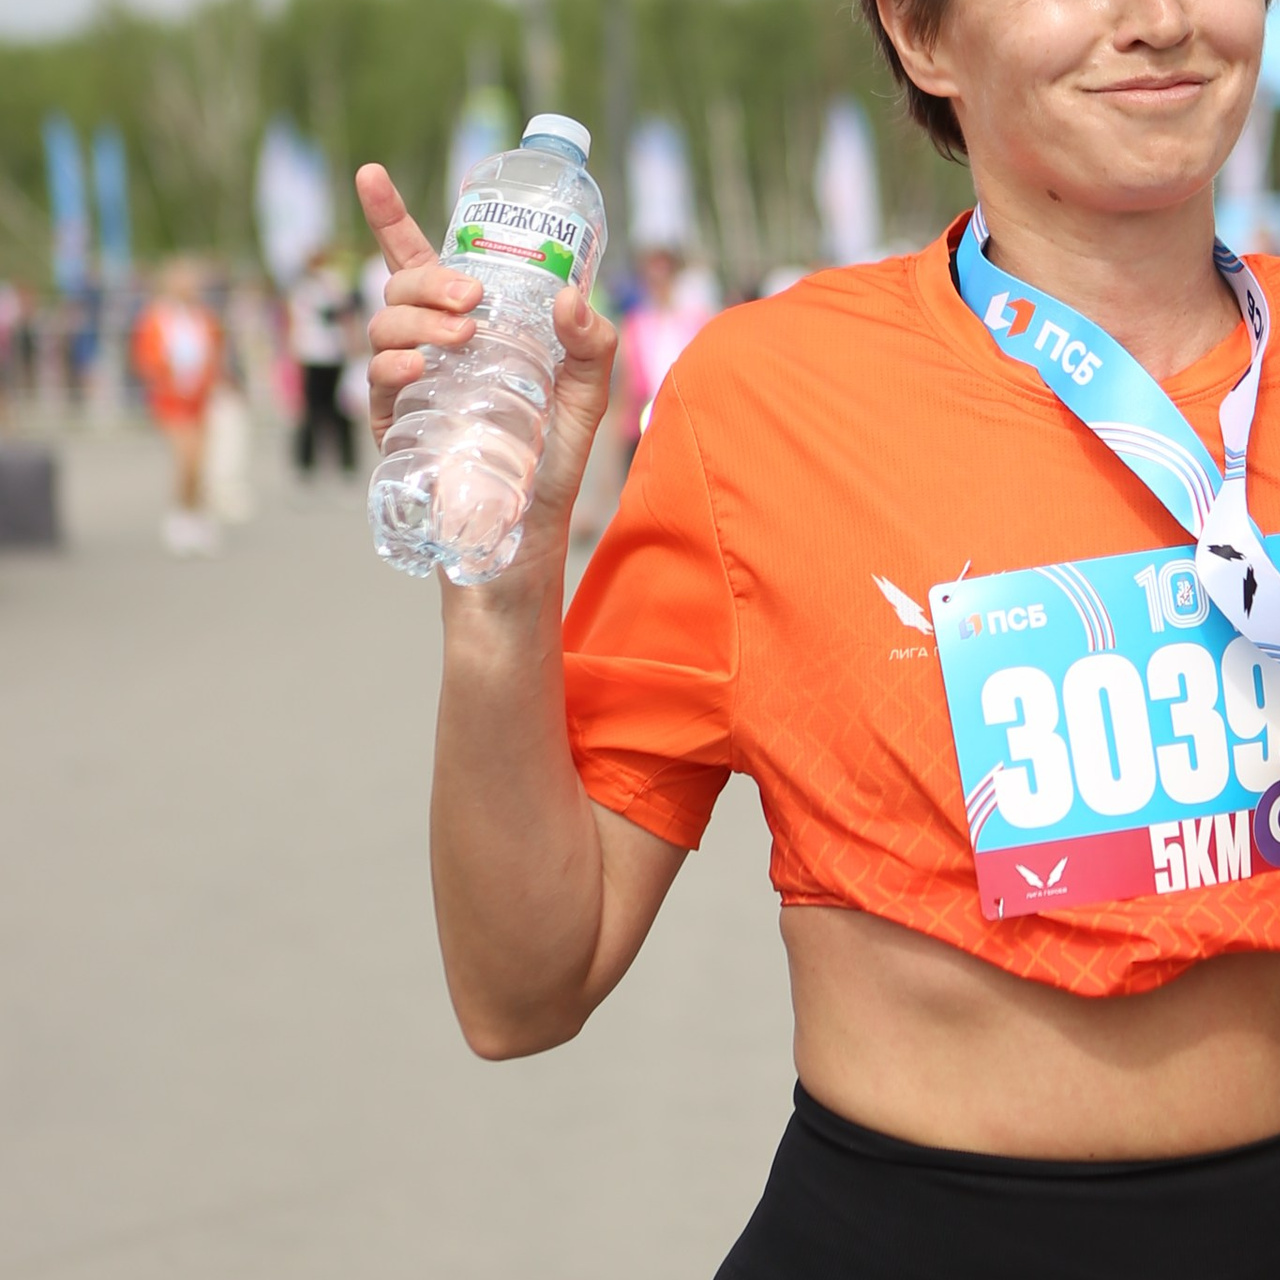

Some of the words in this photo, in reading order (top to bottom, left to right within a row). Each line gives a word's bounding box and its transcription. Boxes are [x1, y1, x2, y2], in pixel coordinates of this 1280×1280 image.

[463, 202, 577, 246] СЕНЕЖСКАЯ
[474, 239, 543, 260] НЕГАЗИРОВАННАЯ
[1034, 320, 1103, 386] ПСБ
[1133, 559, 1210, 633] 10
[986, 603, 1048, 636] ПСБ
[889, 646, 929, 661] ЛИГА
